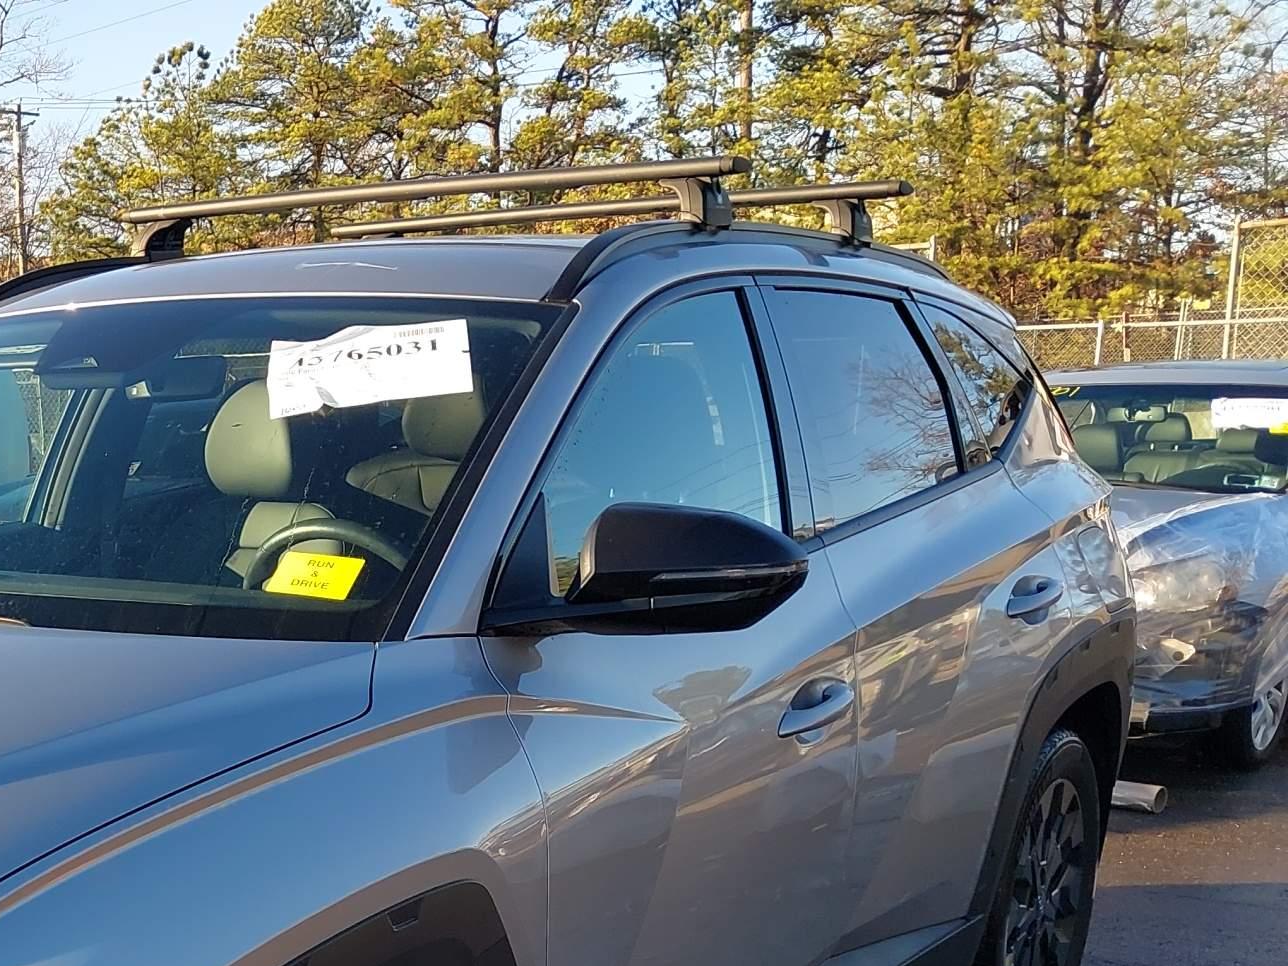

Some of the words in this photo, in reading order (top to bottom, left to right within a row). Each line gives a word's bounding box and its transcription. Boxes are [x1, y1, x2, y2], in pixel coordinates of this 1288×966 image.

[307, 559, 335, 569] RUN
[311, 570, 319, 578] &
[290, 578, 330, 590] DRIVE
